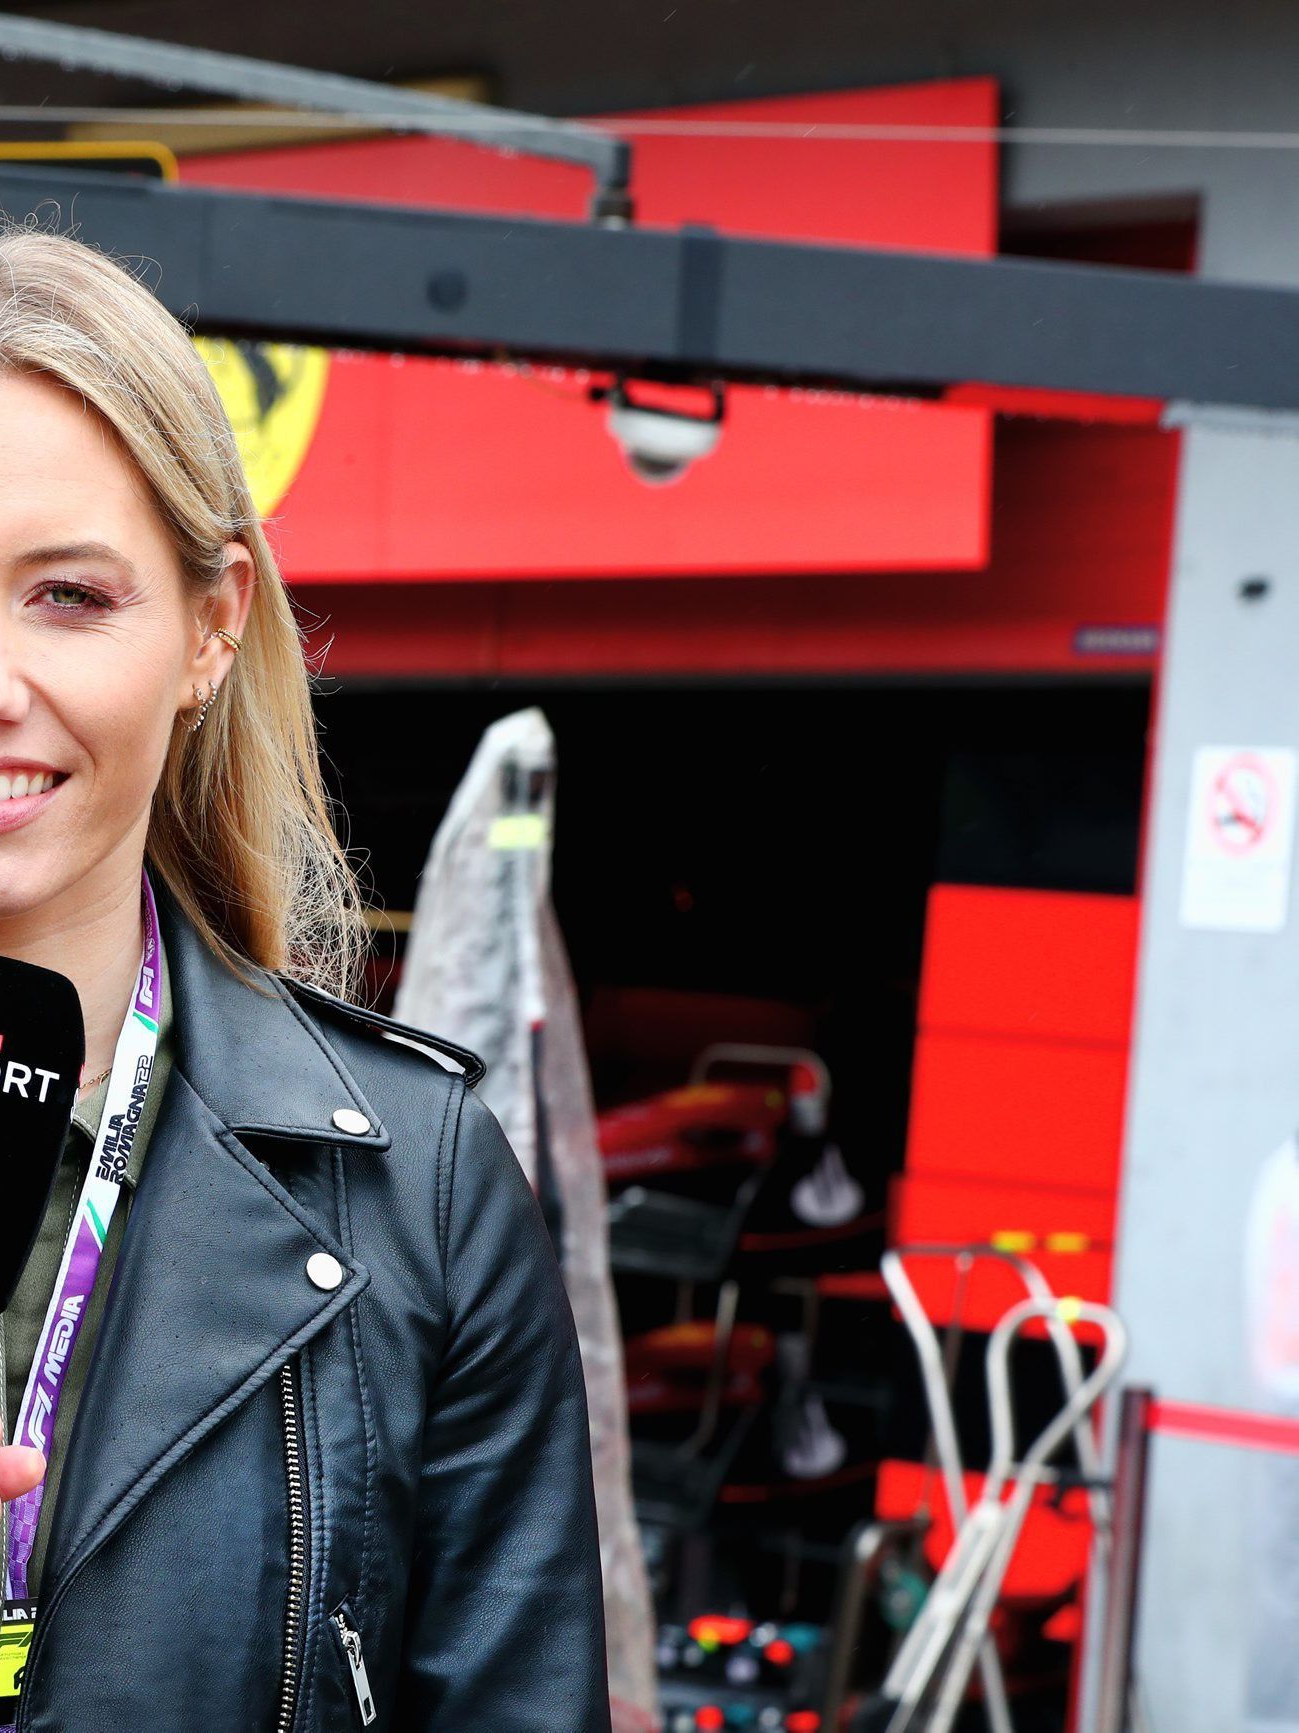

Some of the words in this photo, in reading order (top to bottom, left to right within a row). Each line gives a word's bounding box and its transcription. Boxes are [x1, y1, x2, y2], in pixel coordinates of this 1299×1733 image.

[95, 1113, 126, 1181] EMILIA
[109, 1083, 148, 1186] ROMAGNA
[43, 1294, 85, 1388] MEDIA
[2, 1607, 29, 1621] LIA
